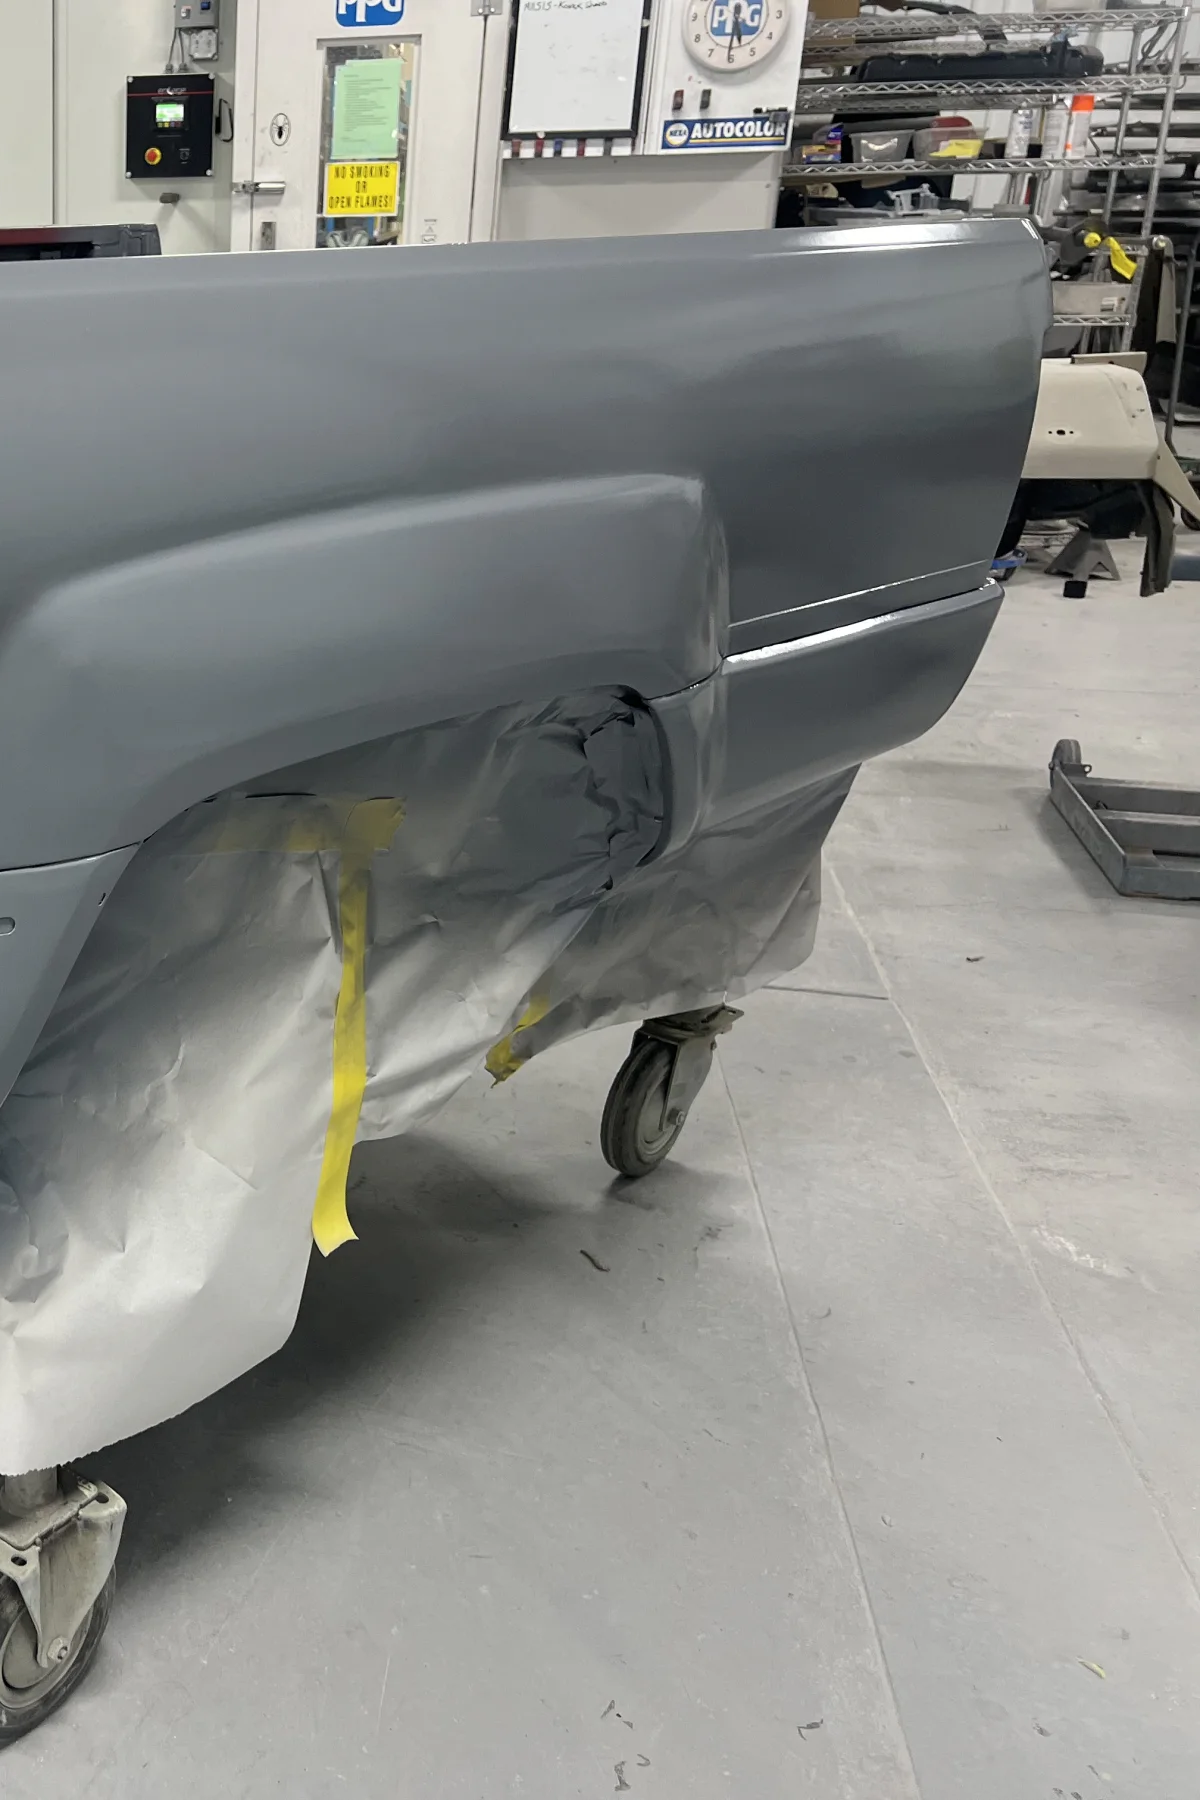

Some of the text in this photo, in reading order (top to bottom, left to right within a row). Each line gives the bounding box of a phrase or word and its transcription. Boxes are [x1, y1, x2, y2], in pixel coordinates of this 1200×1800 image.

[692, 13, 698, 22] 9
[776, 10, 783, 20] 3
[694, 34, 701, 43] 8
[766, 32, 773, 41] 4
[708, 49, 715, 58] 7
[749, 47, 756, 57] 5
[728, 54, 735, 64] 6
[691, 120, 786, 139] AUTOCOLOR
[334, 165, 391, 179] NO SMOKING
[355, 181, 368, 194] OR
[328, 196, 352, 209] OPEN
